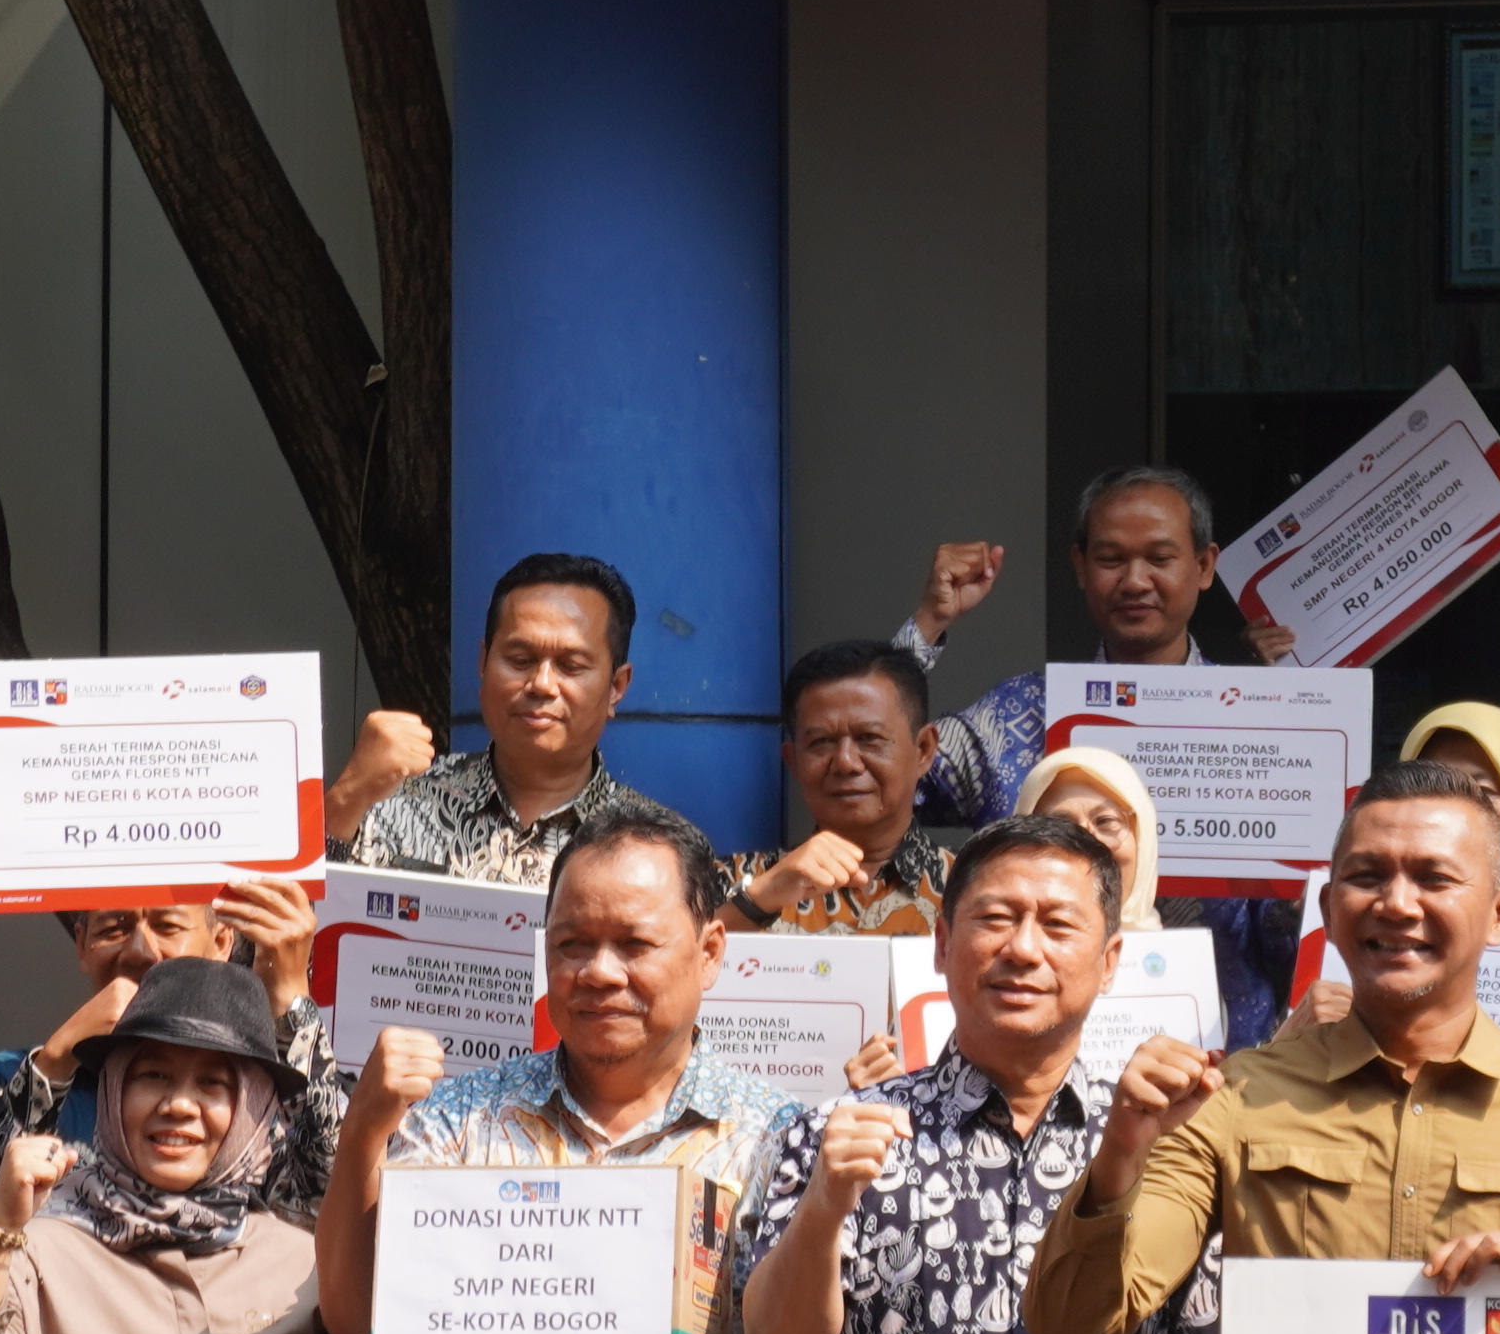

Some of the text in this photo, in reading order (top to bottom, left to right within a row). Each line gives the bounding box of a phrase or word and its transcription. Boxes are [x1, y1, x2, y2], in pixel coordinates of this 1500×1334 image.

[1303, 478, 1464, 611] SMP NEGERI 4 KOTA BOGOR
[1342, 521, 1453, 615] Rp 4.050.000
[1136, 741, 1280, 756] SERAH TERIMA DONASI
[23, 785, 259, 804] SMP NEGERI 6 KOTA BOGOR
[1147, 785, 1312, 802] EGERI 15 KOTA BOGOR
[64, 821, 222, 848] Rp 4.000.000
[1174, 818, 1276, 839] 5.500.000
[370, 995, 526, 1027] SMP NEGERI 20 KOTA
[760, 1030, 826, 1042] BENCANA
[767, 1063, 824, 1077] BOGOR
[413, 1208, 643, 1228] DONASI UNTUK NTT
[498, 1243, 553, 1262] DARI
[453, 1277, 595, 1296] SMP NEGERI
[428, 1311, 617, 1331] SE-KOTA BOGOR
